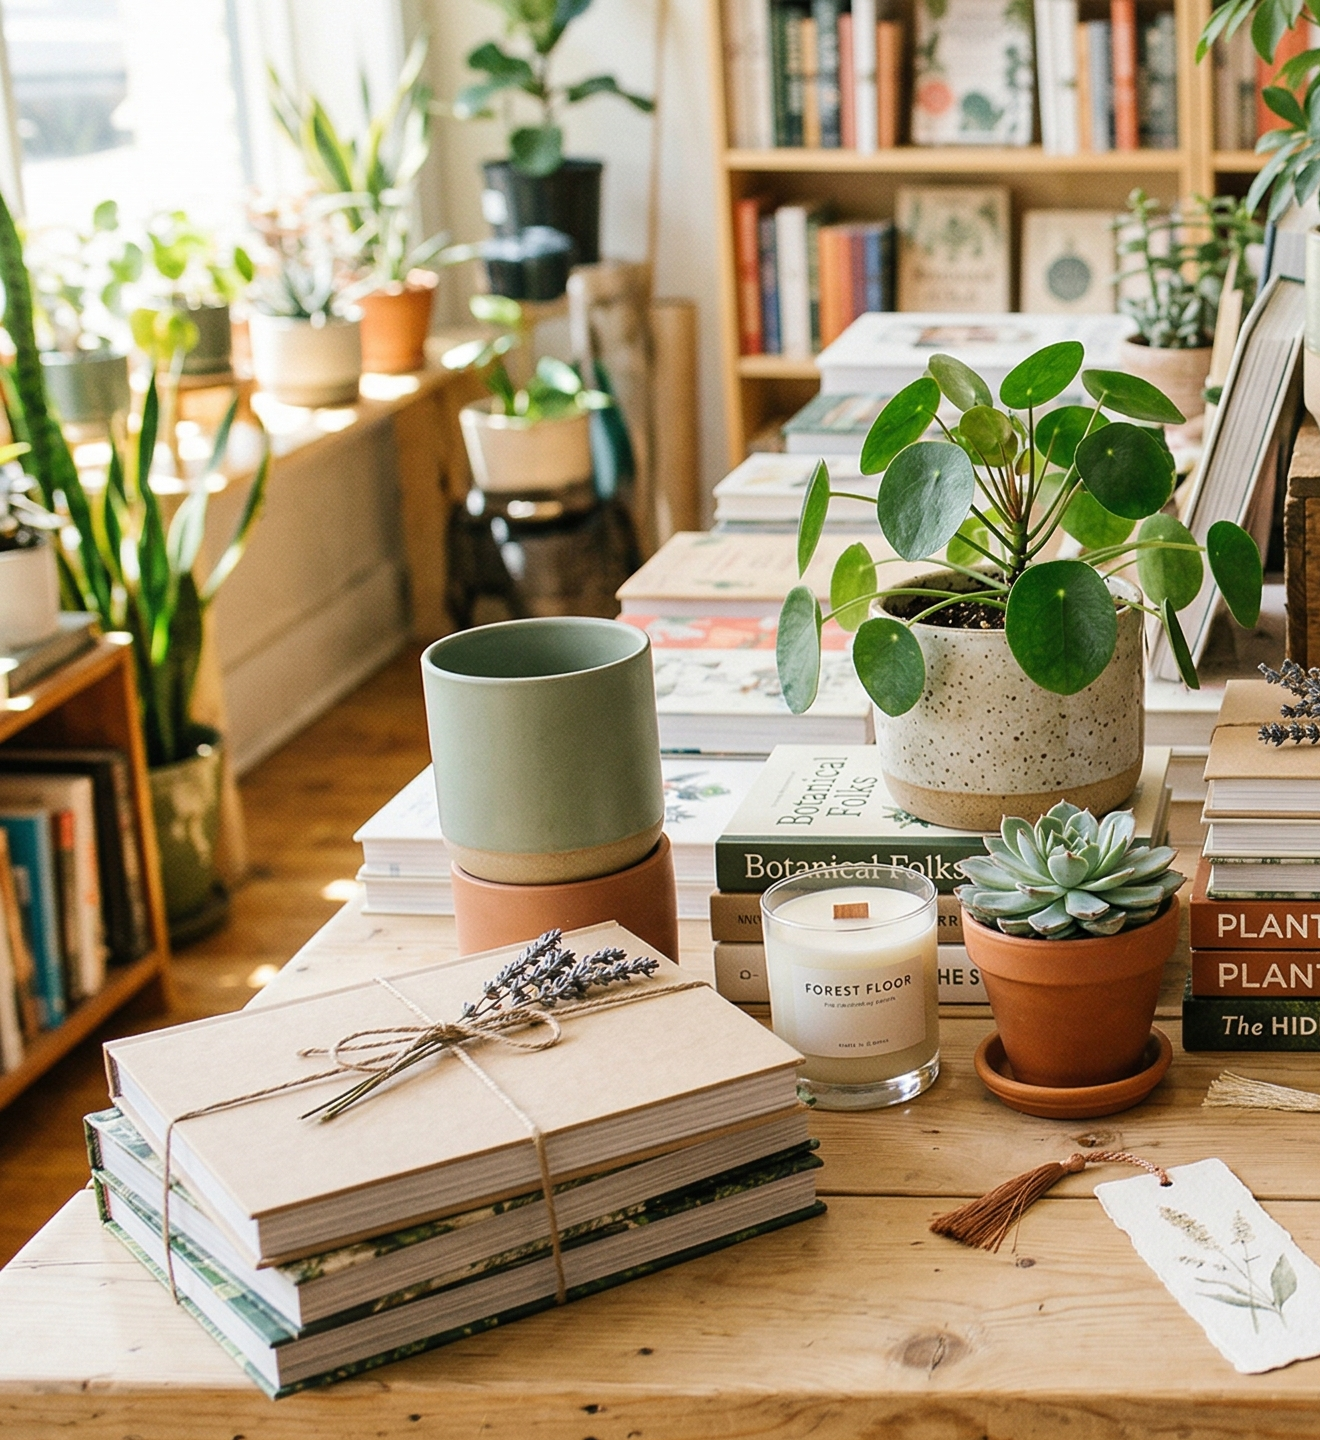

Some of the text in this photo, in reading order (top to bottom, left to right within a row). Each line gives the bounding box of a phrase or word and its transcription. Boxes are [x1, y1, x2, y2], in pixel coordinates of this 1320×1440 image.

[776, 757, 848, 826] Botanical
[826, 776, 878, 818] Folks
[744, 853, 964, 880] Botanical Folks
[805, 974, 912, 997] FOREST FLOOR
[1221, 1015, 1264, 1036] The
